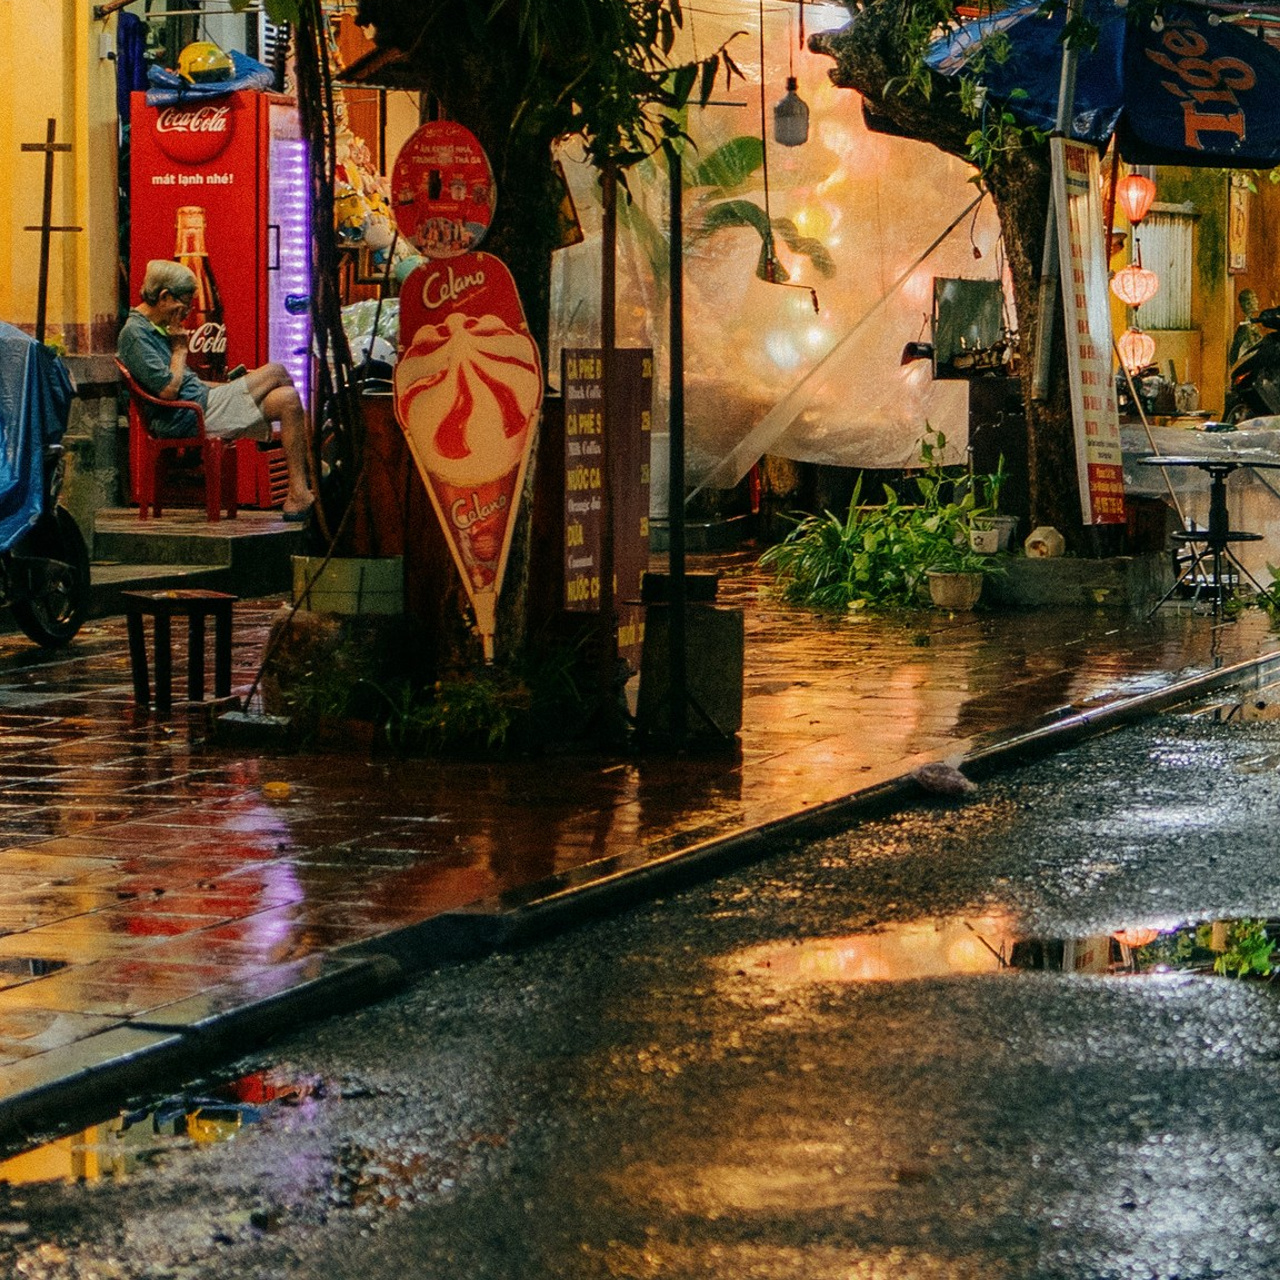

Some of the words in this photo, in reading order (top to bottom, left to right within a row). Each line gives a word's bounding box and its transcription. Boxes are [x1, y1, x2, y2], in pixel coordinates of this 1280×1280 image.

[156, 106, 231, 133] Coca-Cola
[151, 173, 176, 185] mát
[178, 173, 204, 187] lạnh
[206, 172, 234, 185] nhé!
[422, 266, 485, 309] Celano
[589, 467, 601, 489] CA
[451, 493, 507, 530] Celano
